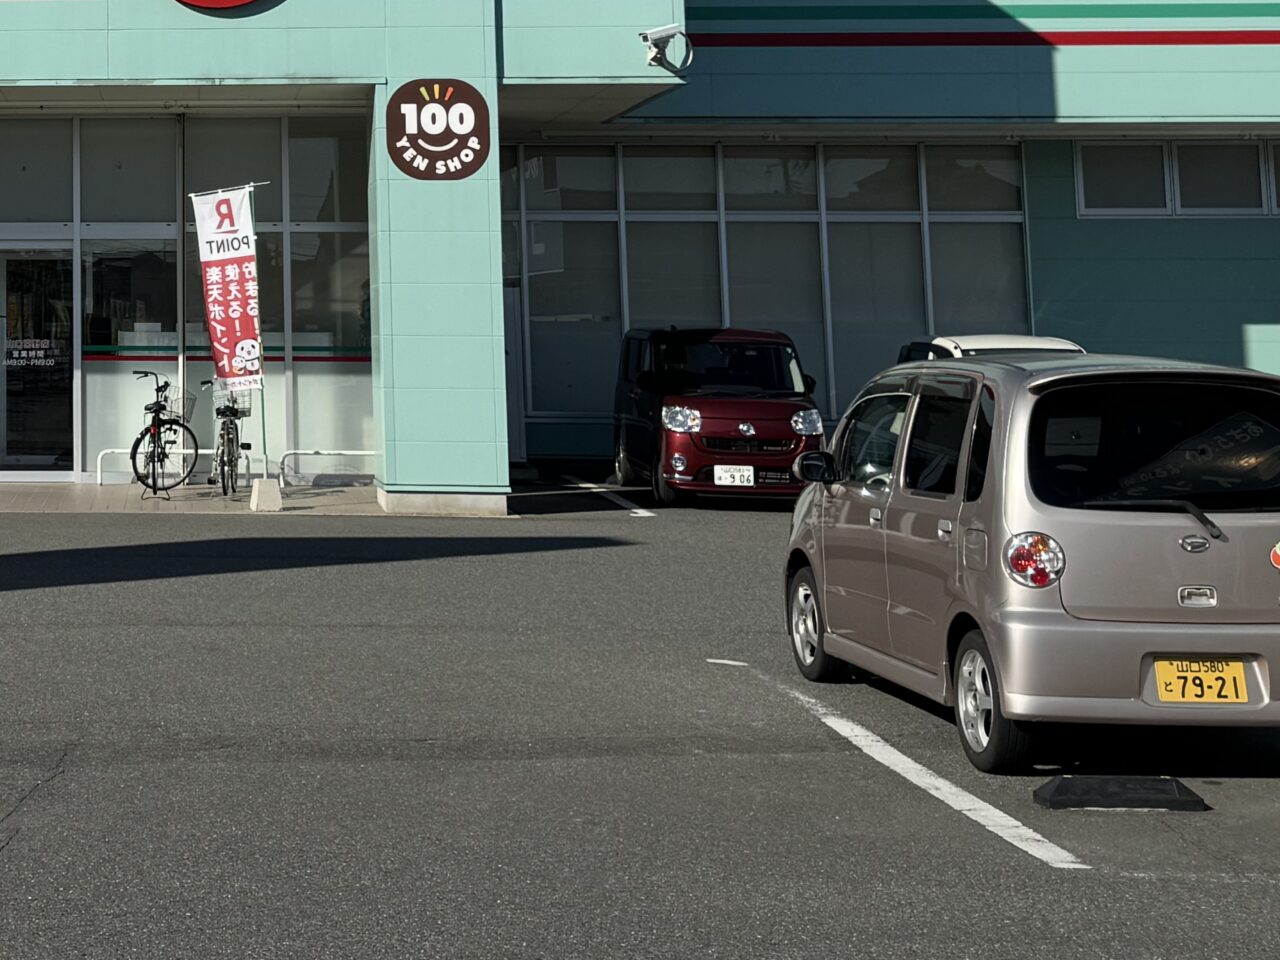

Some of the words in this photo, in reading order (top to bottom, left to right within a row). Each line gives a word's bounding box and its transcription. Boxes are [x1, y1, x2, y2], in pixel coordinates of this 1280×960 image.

[400, 103, 475, 135] 100
[396, 136, 429, 171] YEN
[435, 136, 481, 174] SHOP
[1164, 681, 1174, 693] と
[1176, 675, 1240, 699] 79-21
